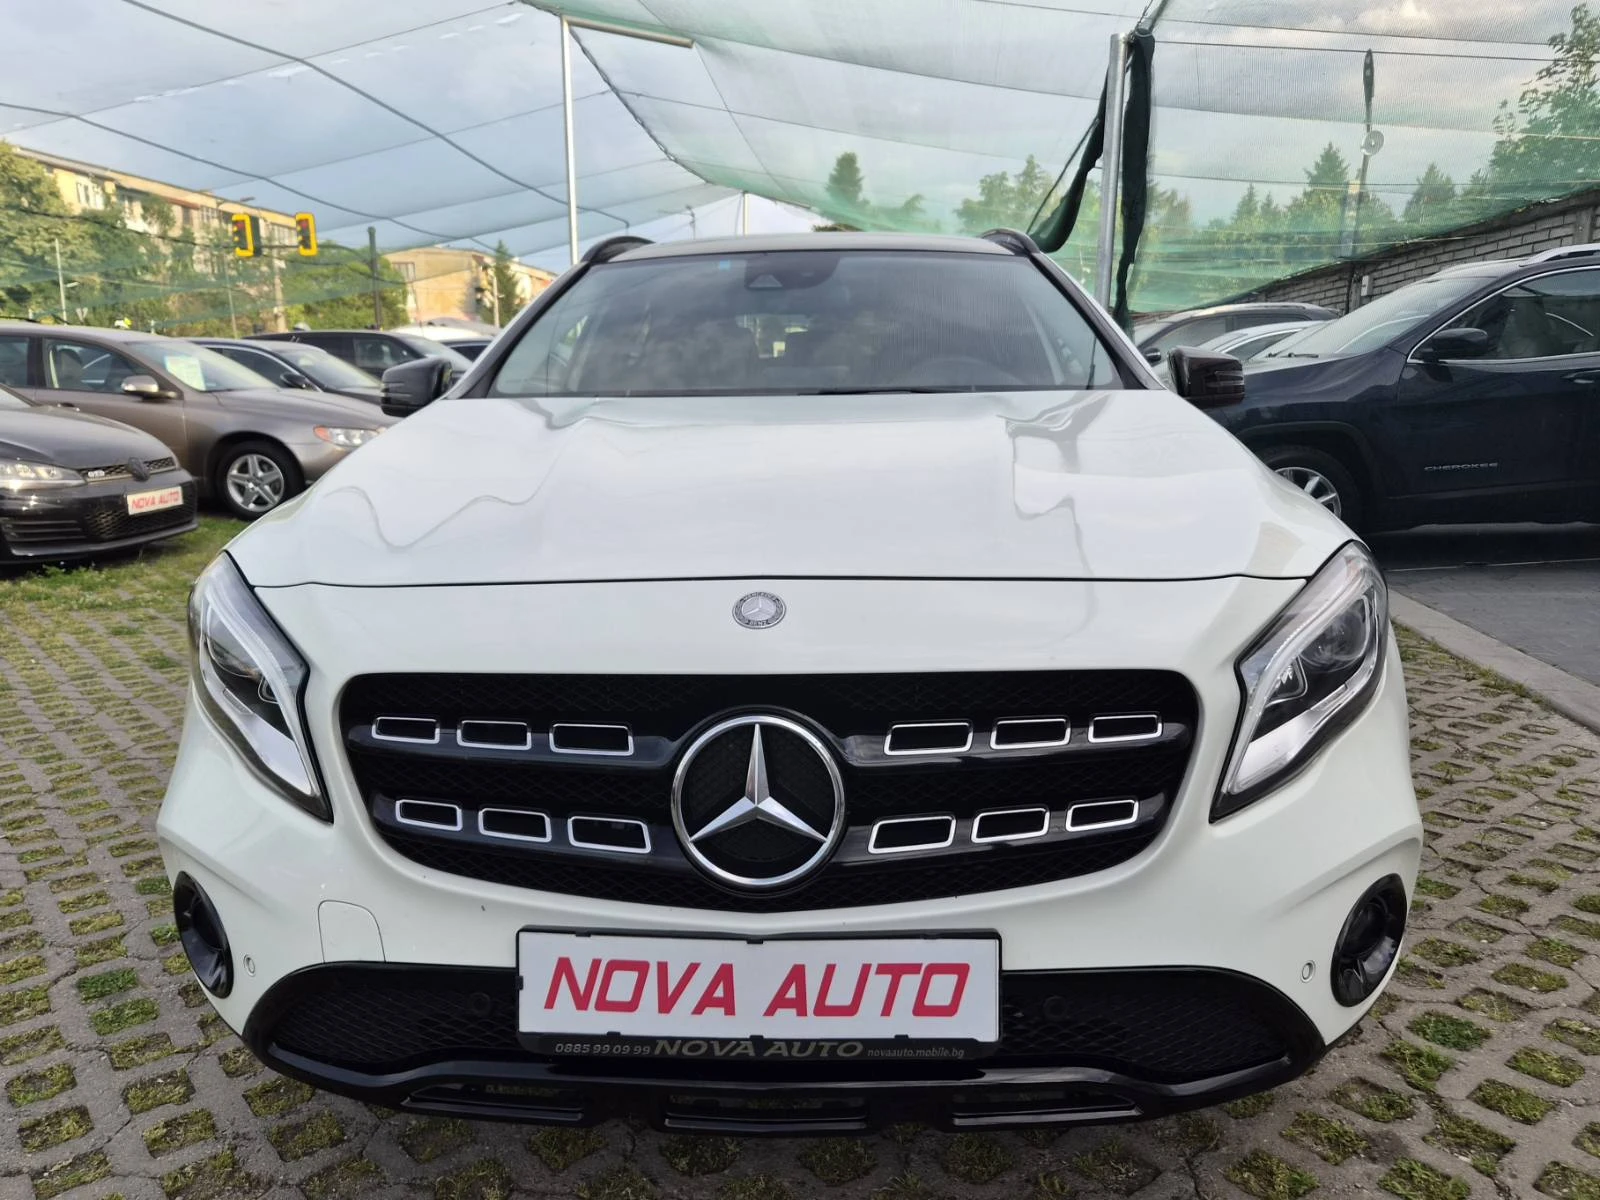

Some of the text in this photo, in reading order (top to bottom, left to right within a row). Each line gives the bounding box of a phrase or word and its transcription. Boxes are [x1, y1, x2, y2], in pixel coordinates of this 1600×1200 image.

[131, 491, 180, 509] NOVA AUTO
[543, 957, 971, 1017] NOVA AUTO
[554, 1043, 650, 1055] 0885 99 09 99
[654, 1039, 864, 1057] NOVA AUTO
[867, 1047, 965, 1058] novaauto.mobile.bg
